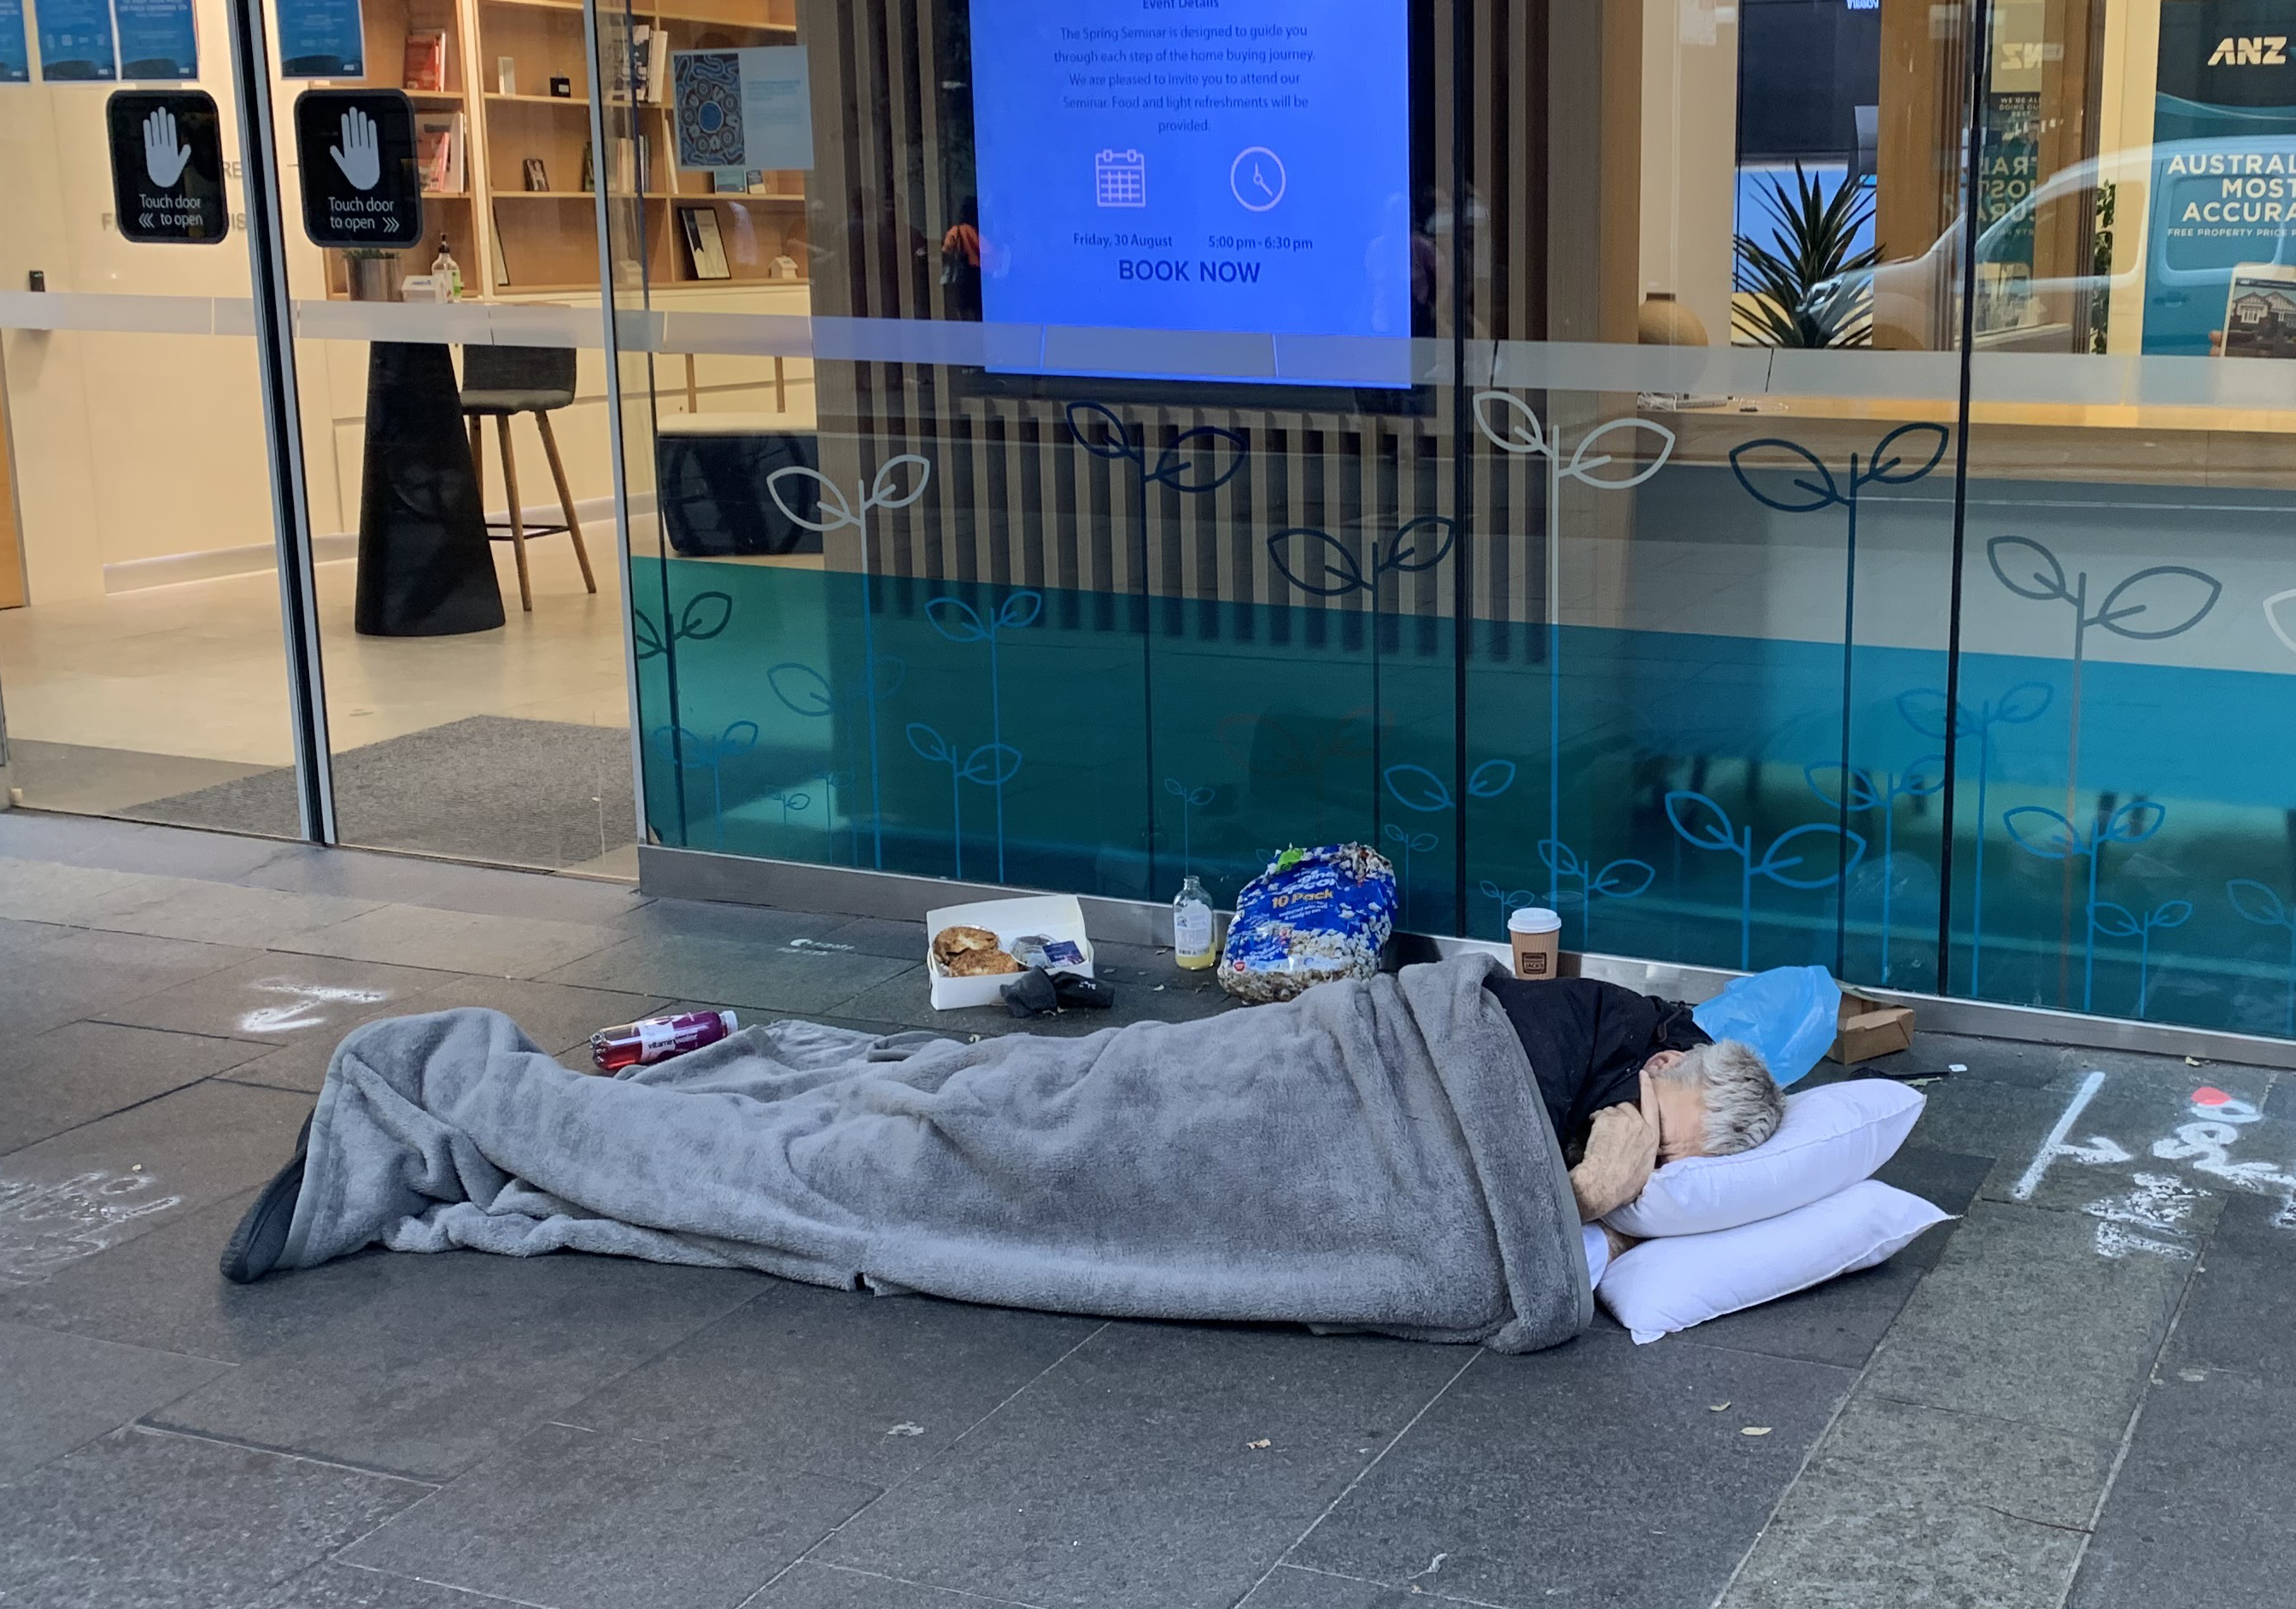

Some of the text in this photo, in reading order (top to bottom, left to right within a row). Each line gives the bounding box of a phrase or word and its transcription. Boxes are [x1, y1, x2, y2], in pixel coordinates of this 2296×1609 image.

[1143, 0, 1219, 9] Event Details
[1061, 23, 1308, 42] The Spring Seminar is designed to guide you
[1054, 48, 1316, 66] through each step of the home buying journey.
[2207, 37, 2287, 66] ANZ
[1069, 71, 1300, 88] We are pleased to invite you to attend our
[1111, 96, 1139, 108] Food
[1142, 96, 1163, 108] and
[1166, 96, 1191, 111] light
[1194, 94, 1268, 109] refreshments
[1271, 94, 1291, 108] will
[1293, 94, 1309, 108] be
[1158, 118, 1211, 134] provided.
[2222, 178, 2296, 199] MOST
[139, 193, 202, 209] Touch door
[328, 196, 395, 213] Touch door
[161, 214, 204, 229] to open
[330, 216, 376, 233] to open
[1074, 232, 1173, 249] Friday, 30 August
[2168, 228, 2194, 237] FREE
[2197, 228, 2253, 237] PROPERTY
[2256, 228, 2287, 237] PRICE
[1209, 235, 1234, 249] 5:00
[1119, 259, 1261, 283] BOOK NOW
[1272, 888, 1333, 909] 10 Pack
